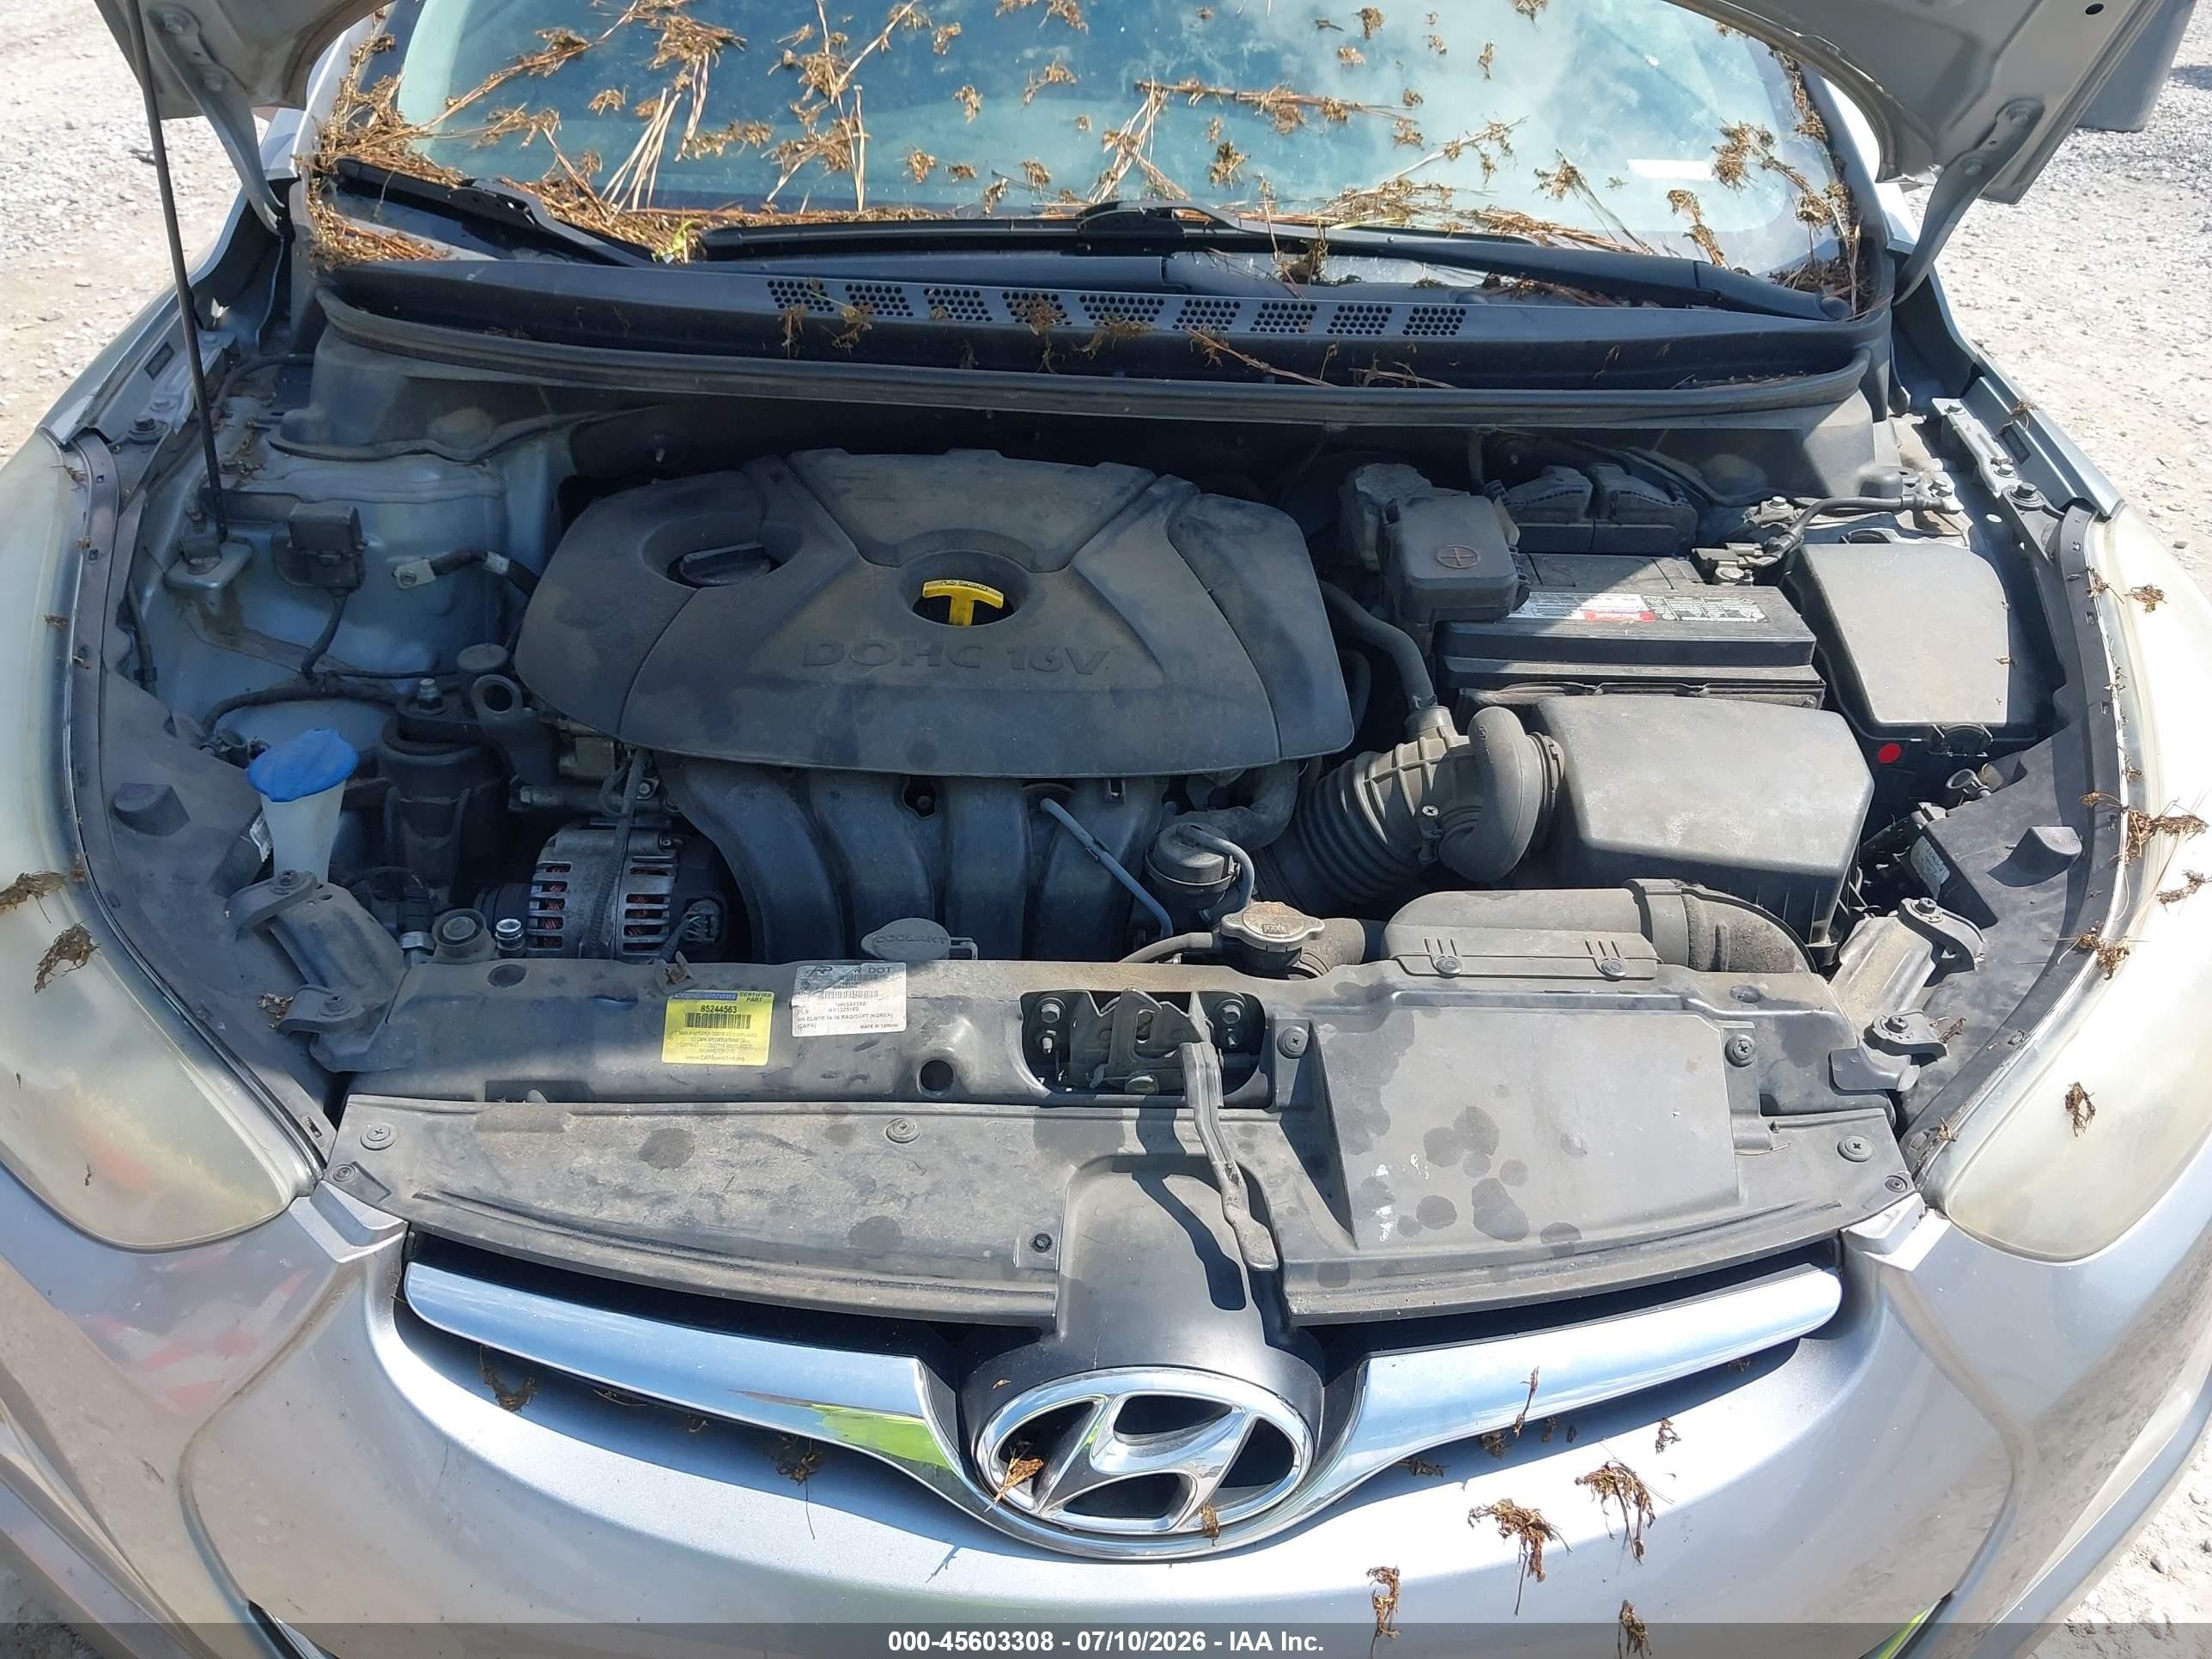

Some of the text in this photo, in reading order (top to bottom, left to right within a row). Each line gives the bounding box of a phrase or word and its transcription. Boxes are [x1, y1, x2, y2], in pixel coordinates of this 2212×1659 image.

[802, 639, 1110, 676] DOHC 16V
[701, 1005, 738, 1014] 85244563
